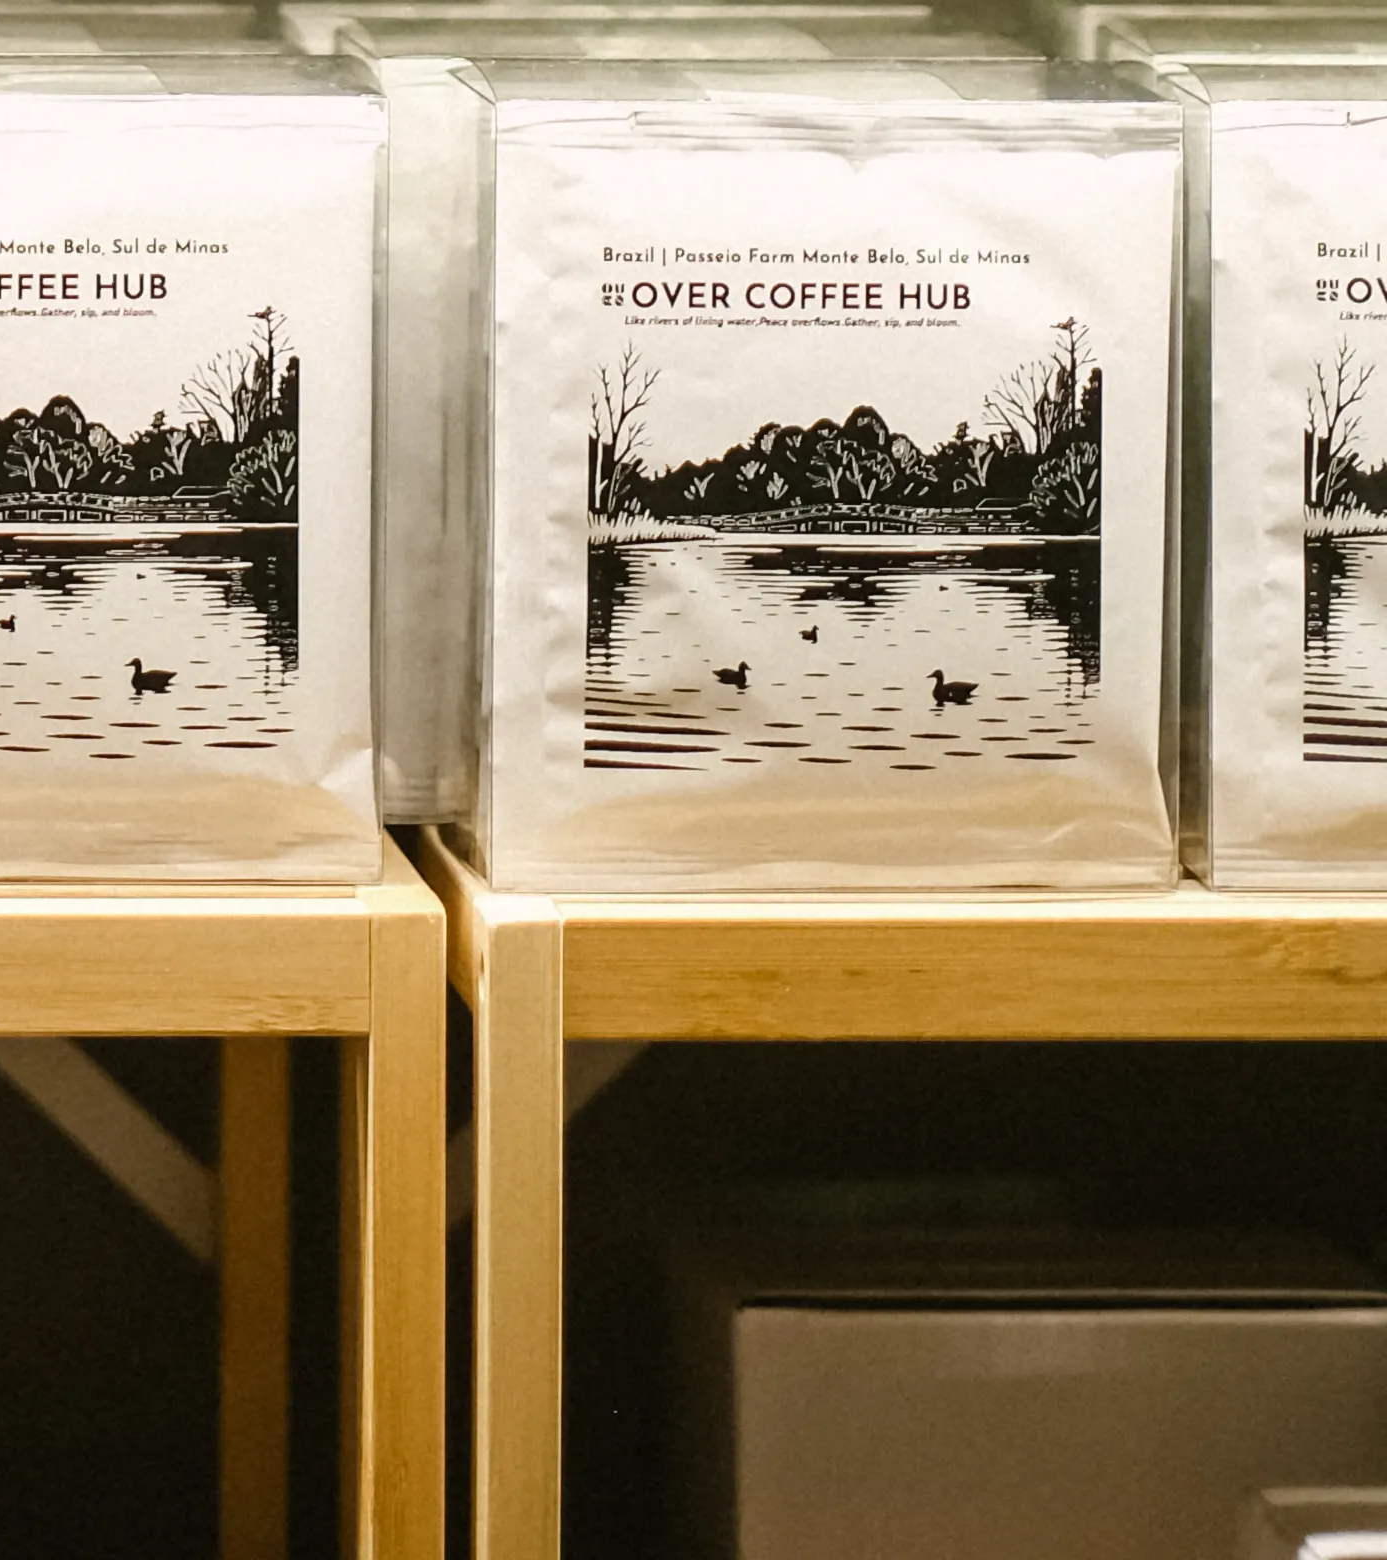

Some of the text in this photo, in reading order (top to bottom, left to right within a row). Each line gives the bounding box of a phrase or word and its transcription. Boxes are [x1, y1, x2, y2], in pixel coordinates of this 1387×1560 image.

[63, 237, 106, 257] Belo,
[111, 237, 139, 255] Sul
[145, 237, 168, 254] de
[175, 238, 229, 254] Minas
[603, 245, 655, 263] Brazil
[674, 247, 742, 264] Passeio
[748, 247, 795, 264] Farm
[802, 248, 860, 265] Monte
[867, 246, 910, 267] Belo,
[915, 247, 942, 265] Sul
[948, 247, 970, 264] de
[977, 249, 1031, 265] Minas
[1317, 241, 1369, 259] Brazil
[95, 272, 168, 301] HUB
[631, 281, 732, 310] OVER
[744, 282, 884, 310] COFFEE
[898, 282, 972, 311] HUB
[100, 307, 121, 317] and
[624, 315, 647, 326] Like
[681, 315, 694, 327] of
[904, 317, 925, 328] and
